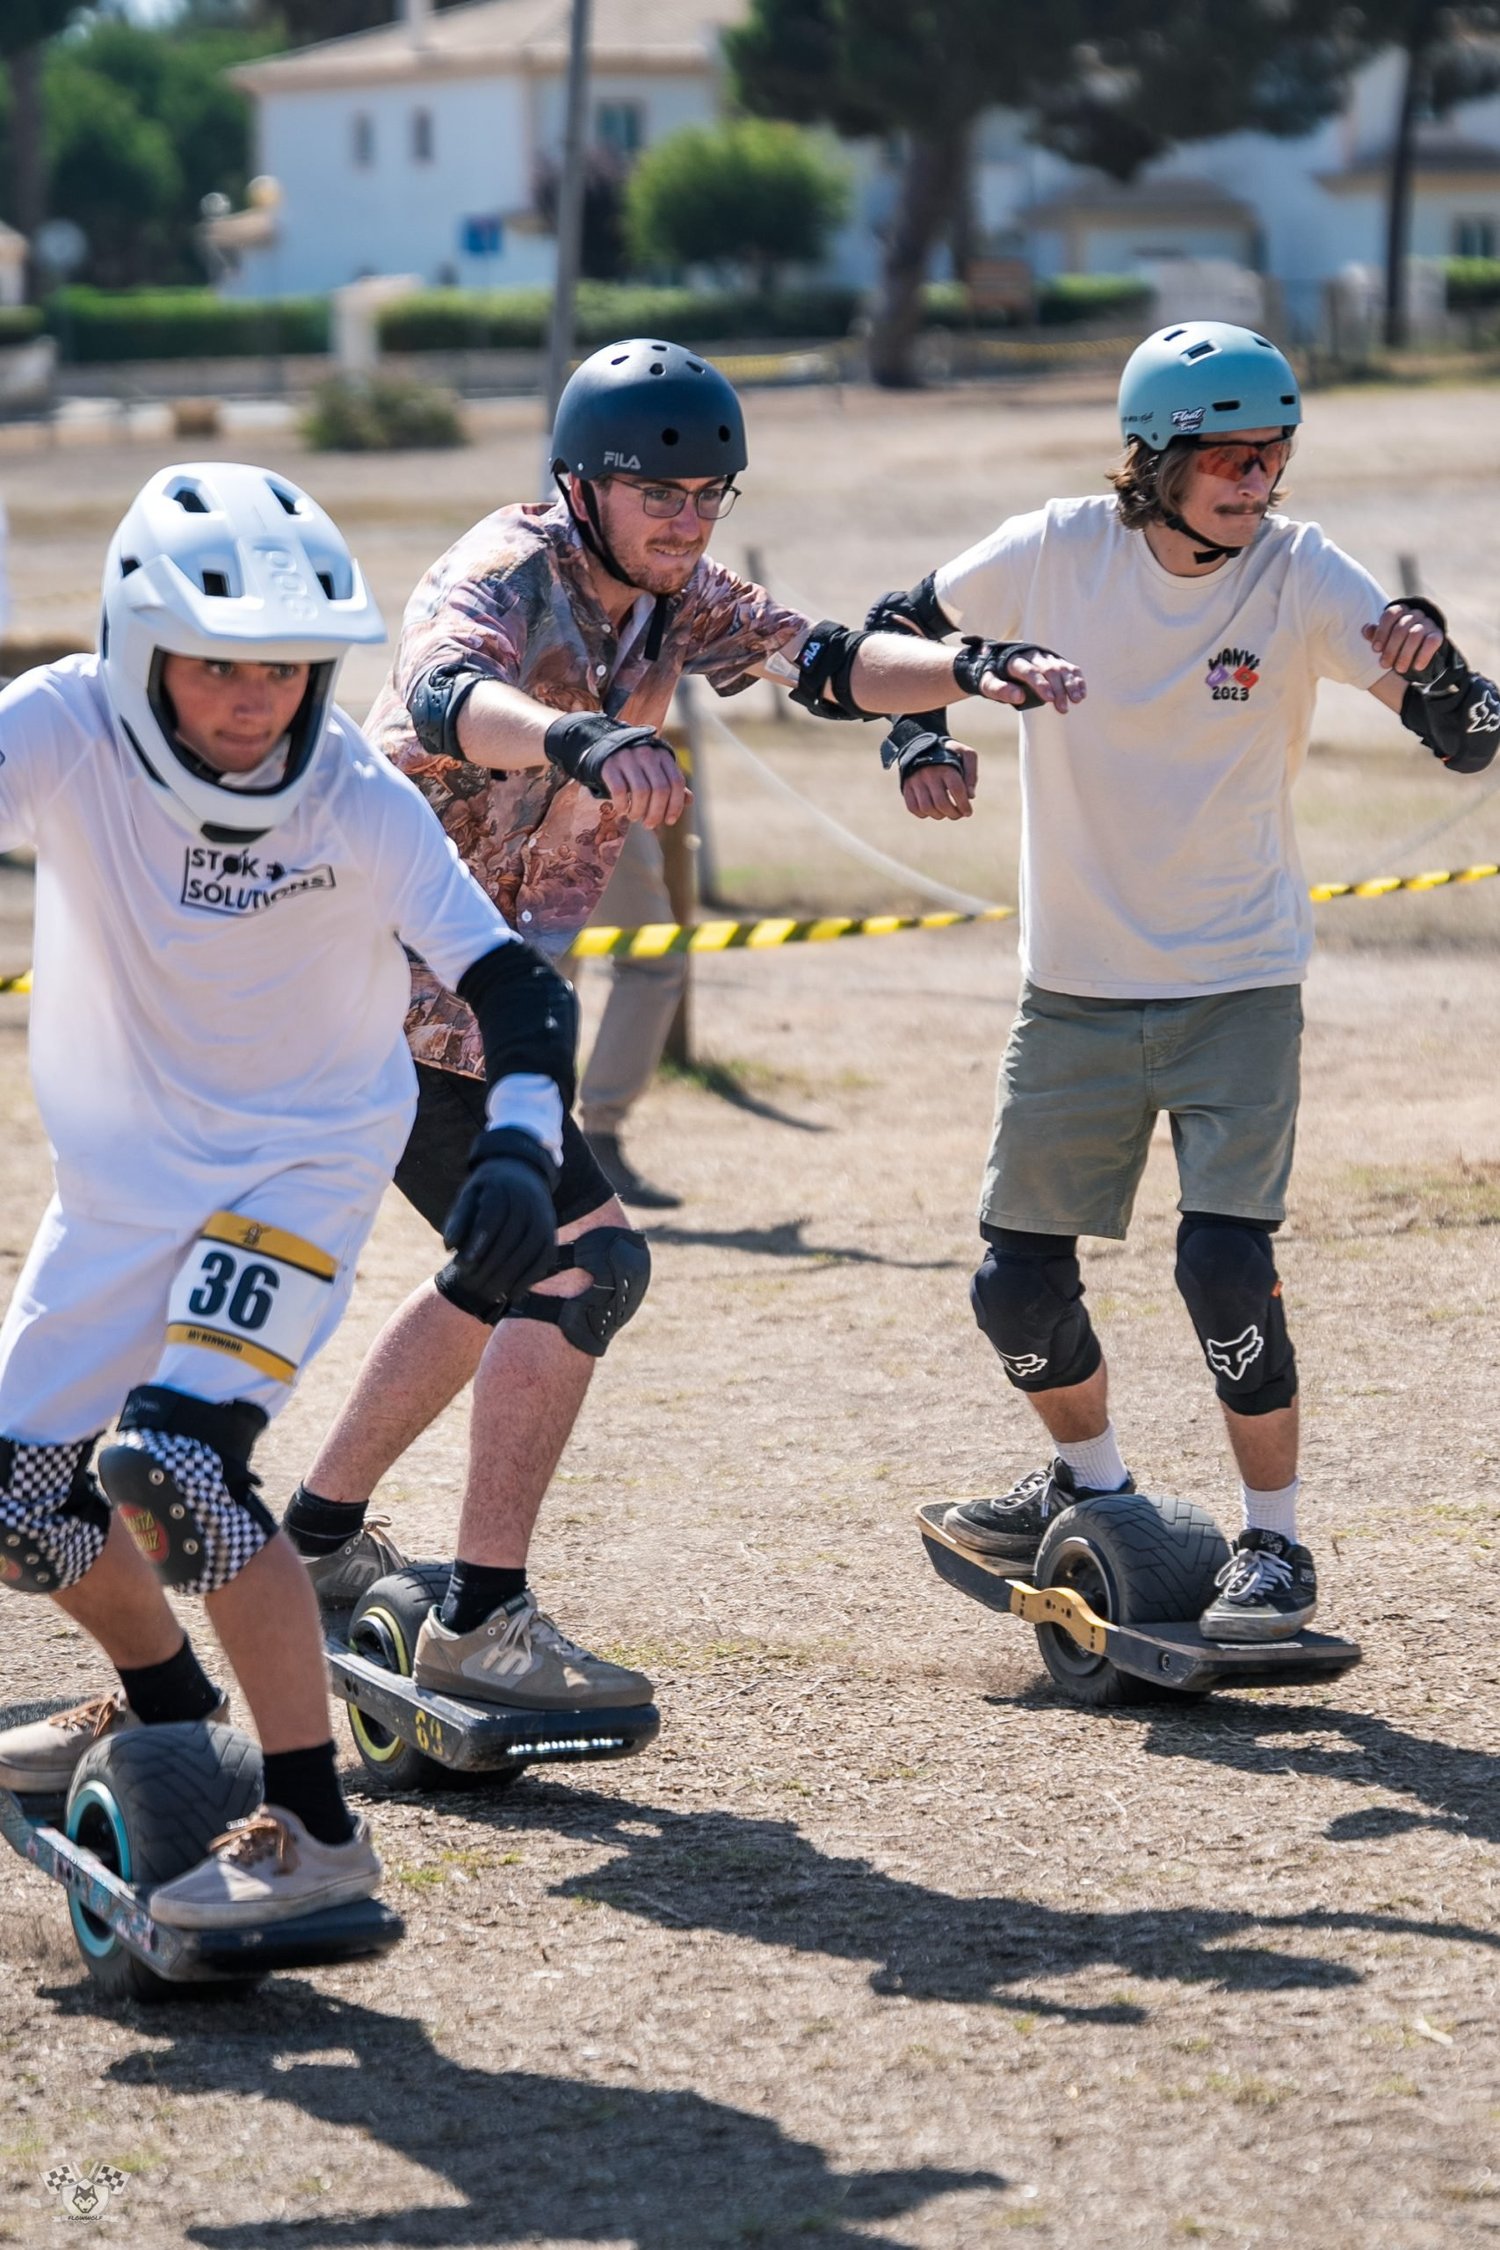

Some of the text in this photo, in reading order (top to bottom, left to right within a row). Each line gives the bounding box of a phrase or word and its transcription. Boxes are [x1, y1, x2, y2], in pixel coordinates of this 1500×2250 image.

[603, 450, 642, 470] FILA
[1211, 685, 1250, 702] 2023
[188, 1250, 281, 1332] 36
[415, 1709, 444, 1756] 69
